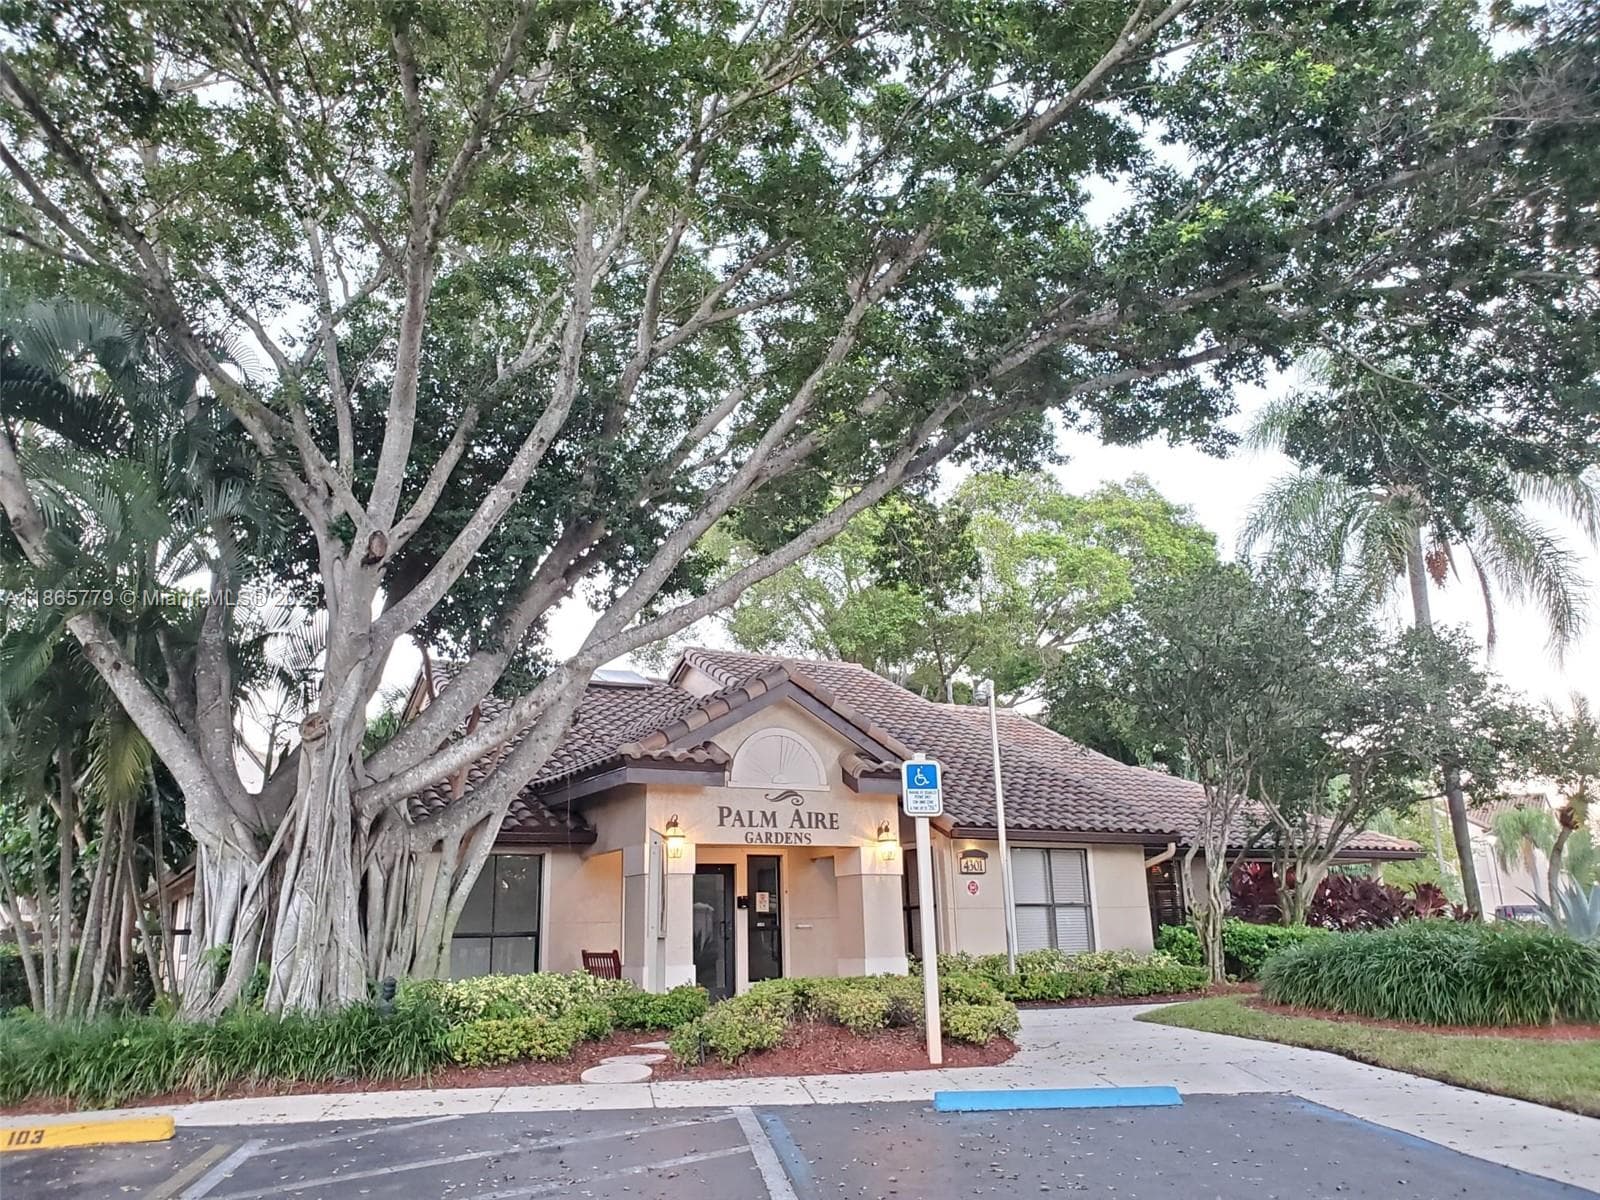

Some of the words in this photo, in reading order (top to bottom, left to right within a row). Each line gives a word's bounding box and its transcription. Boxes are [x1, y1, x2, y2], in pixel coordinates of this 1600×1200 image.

[744, 831, 812, 845] GARDENS
[963, 859, 984, 872] 4301
[7, 1129, 46, 1146] 103
